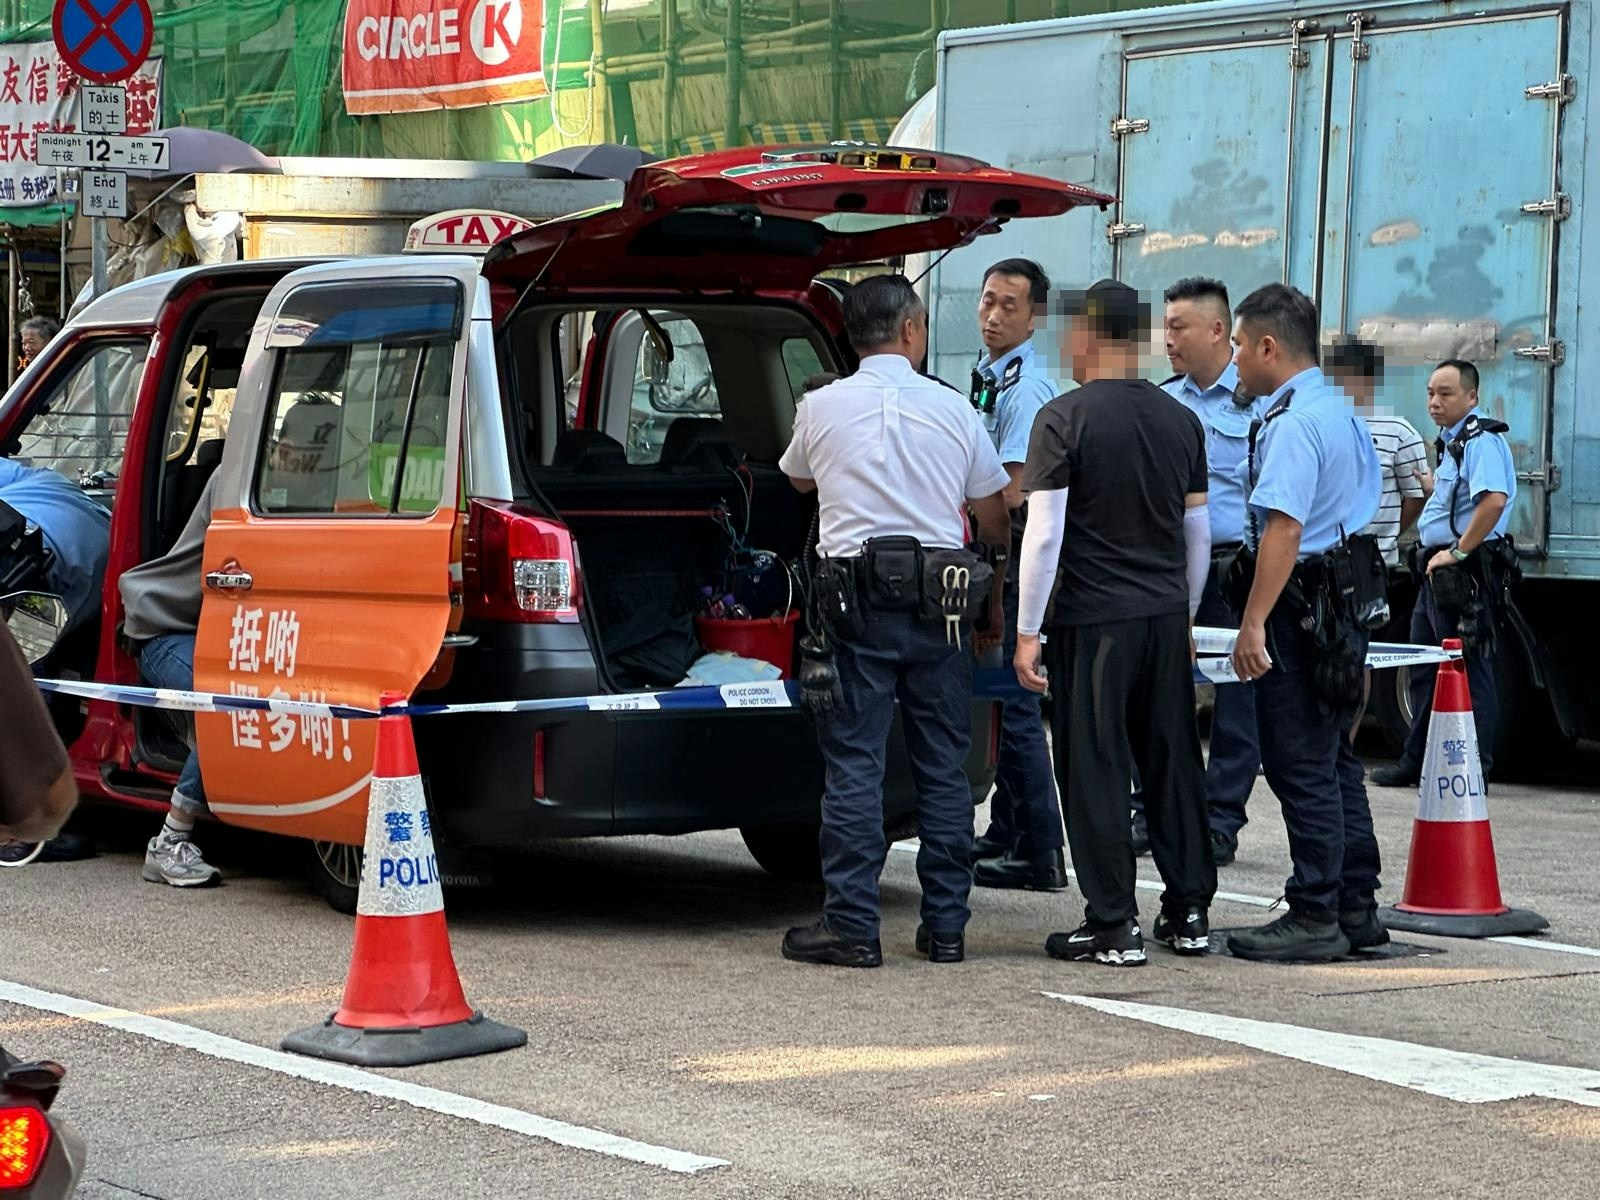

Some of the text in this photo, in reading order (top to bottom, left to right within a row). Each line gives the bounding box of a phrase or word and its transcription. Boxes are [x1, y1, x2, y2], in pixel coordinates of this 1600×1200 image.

[356, 2, 518, 62] CIRCLE K
[88, 92, 119, 103] Taxis
[89, 110, 119, 124] 的士
[42, 137, 82, 147] midnight
[151, 142, 165, 164] 7
[51, 150, 148, 165] 午夜 上午
[93, 176, 116, 188] End
[437, 216, 529, 244] TAX
[228, 604, 301, 678] 抵啲
[728, 687, 770, 696] POLICE CORDON
